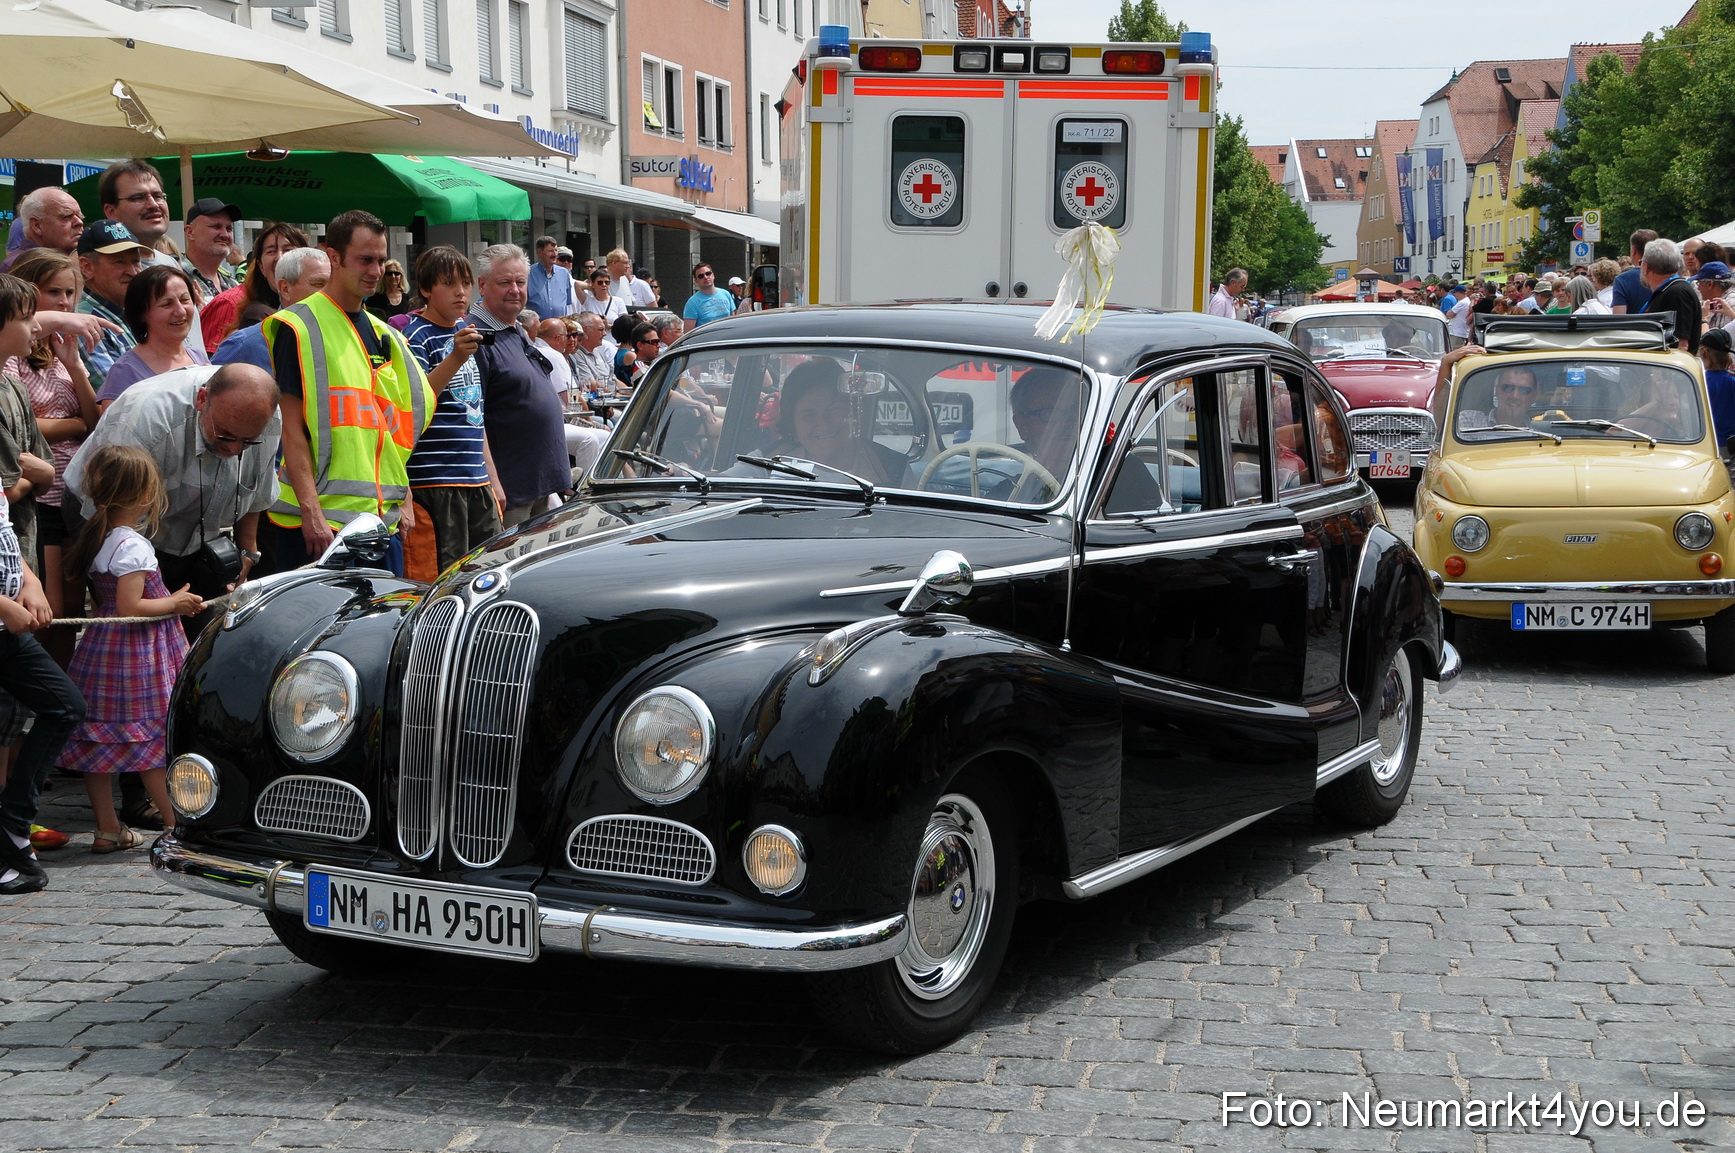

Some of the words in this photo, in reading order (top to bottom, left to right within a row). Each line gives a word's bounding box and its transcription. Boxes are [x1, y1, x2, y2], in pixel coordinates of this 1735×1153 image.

[1084, 128, 1094, 137] 71
[1103, 128, 1115, 137] 22
[203, 165, 312, 177] Neumarkter
[903, 163, 952, 187] BAYERISCHES
[1066, 165, 1114, 189] BAYERISCHES
[902, 189, 925, 214] ROTES
[927, 190, 953, 214] KREUZ
[1065, 192, 1088, 217] ROTES
[1090, 193, 1115, 217] KREUZ
[1384, 452, 1393, 464] R
[1371, 465, 1409, 477] 07642
[1565, 535, 1597, 543] FIAT
[1526, 606, 1555, 626] NM
[1571, 606, 1583, 626] C
[1590, 605, 1649, 626] 974H
[316, 905, 324, 917] D
[330, 881, 368, 926] NM
[392, 891, 432, 936] HA
[442, 899, 526, 948] 950H
